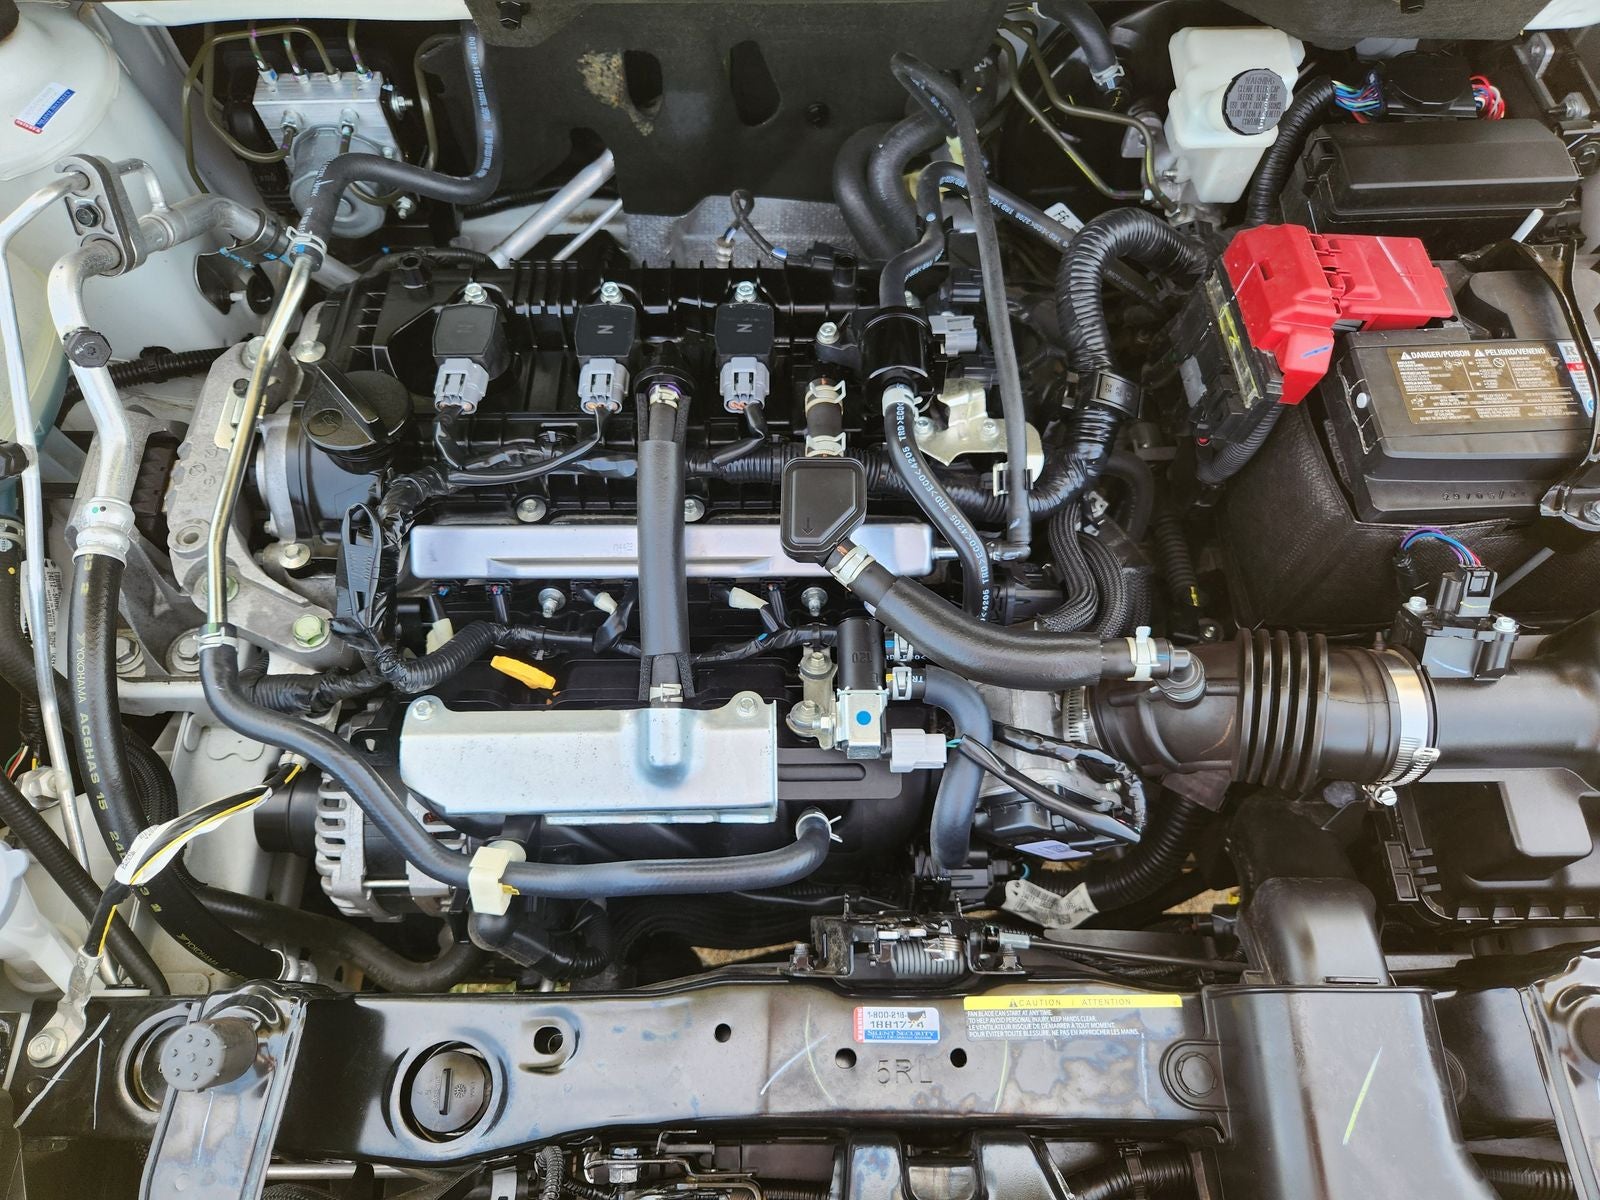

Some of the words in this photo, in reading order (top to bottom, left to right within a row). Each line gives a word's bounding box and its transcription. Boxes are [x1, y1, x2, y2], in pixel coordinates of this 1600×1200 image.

[1410, 350, 1471, 359] DANGER/POISON
[1484, 347, 1546, 356] PELIGRO/VENENO
[77, 646, 86, 703] YOKOHAMA
[96, 791, 108, 811] 15
[1081, 998, 1131, 1006] ATTENTION
